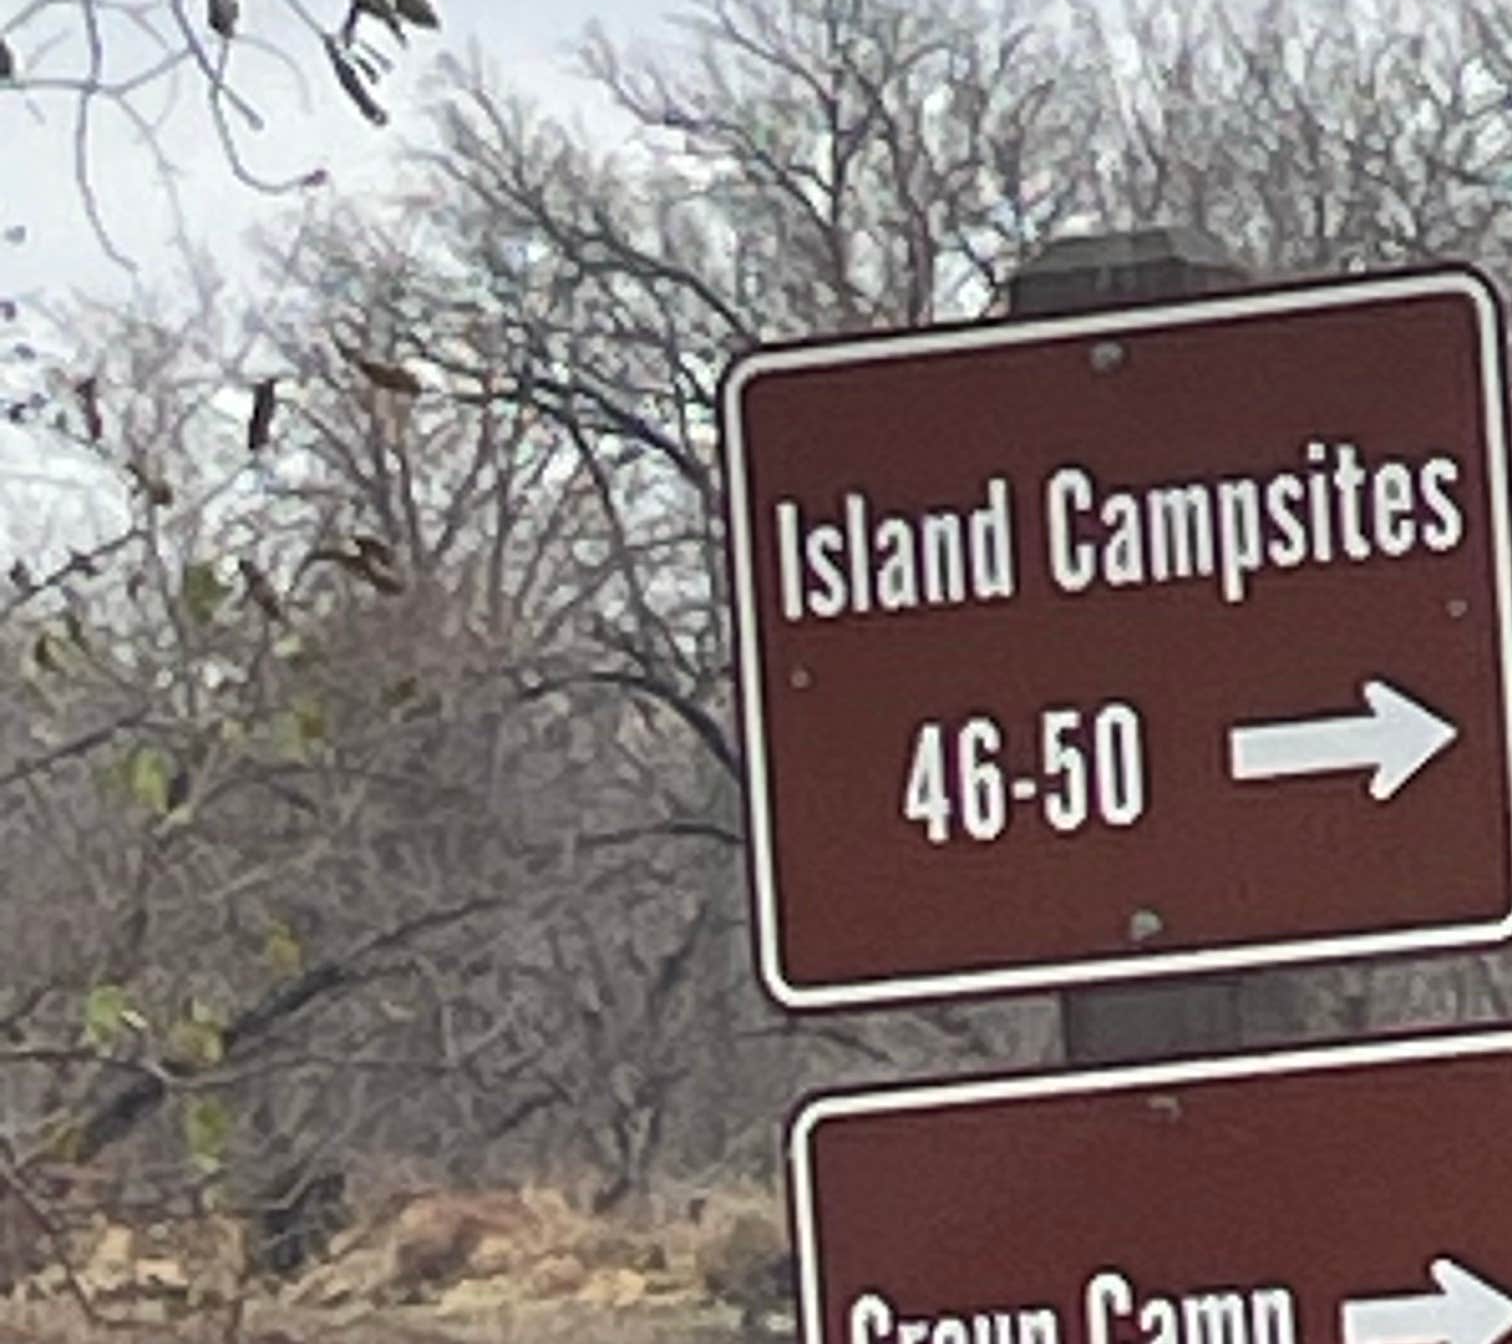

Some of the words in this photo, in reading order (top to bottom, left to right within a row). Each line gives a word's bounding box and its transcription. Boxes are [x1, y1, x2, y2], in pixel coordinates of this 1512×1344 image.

[776, 478, 1014, 620] Island
[1048, 444, 1463, 603] Campsites
[904, 704, 1143, 843] 46-50
